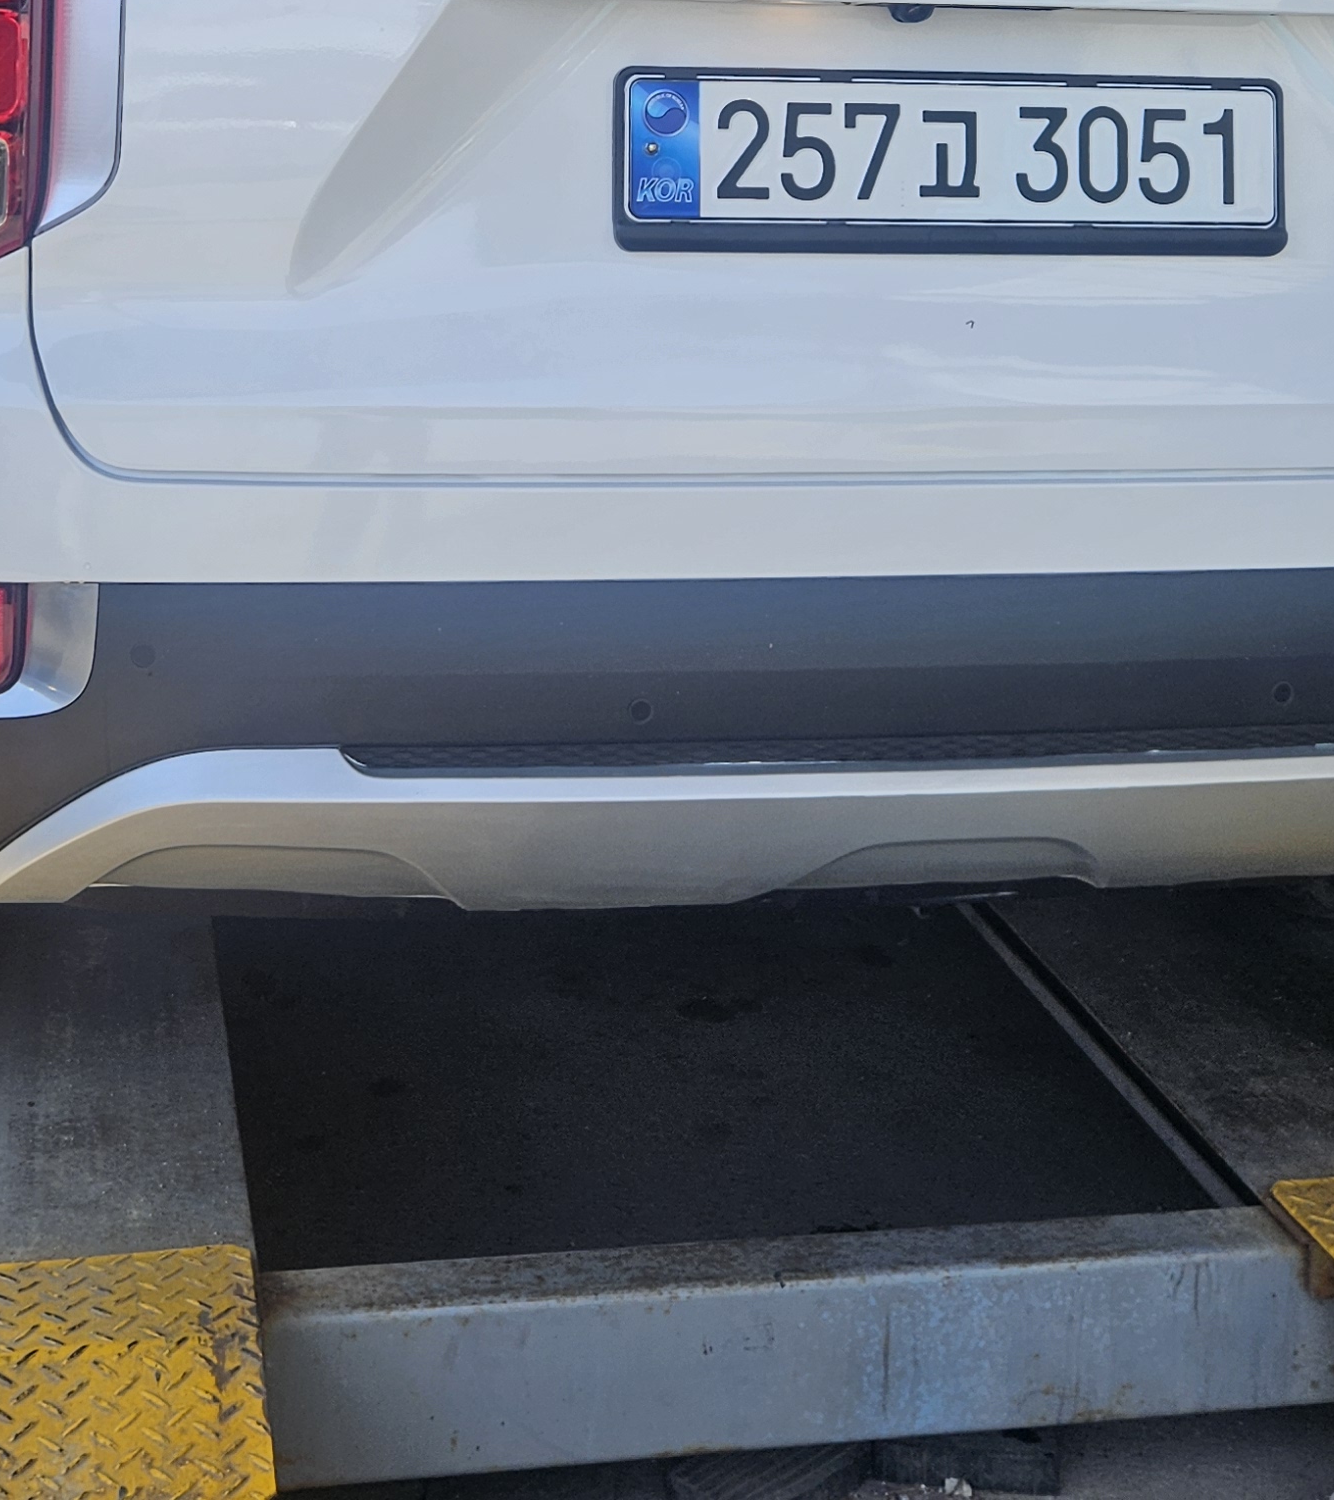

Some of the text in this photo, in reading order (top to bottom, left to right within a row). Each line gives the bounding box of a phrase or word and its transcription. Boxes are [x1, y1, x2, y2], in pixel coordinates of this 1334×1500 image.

[717, 98, 1234, 206] 257고 3051
[636, 177, 695, 203] KOR
